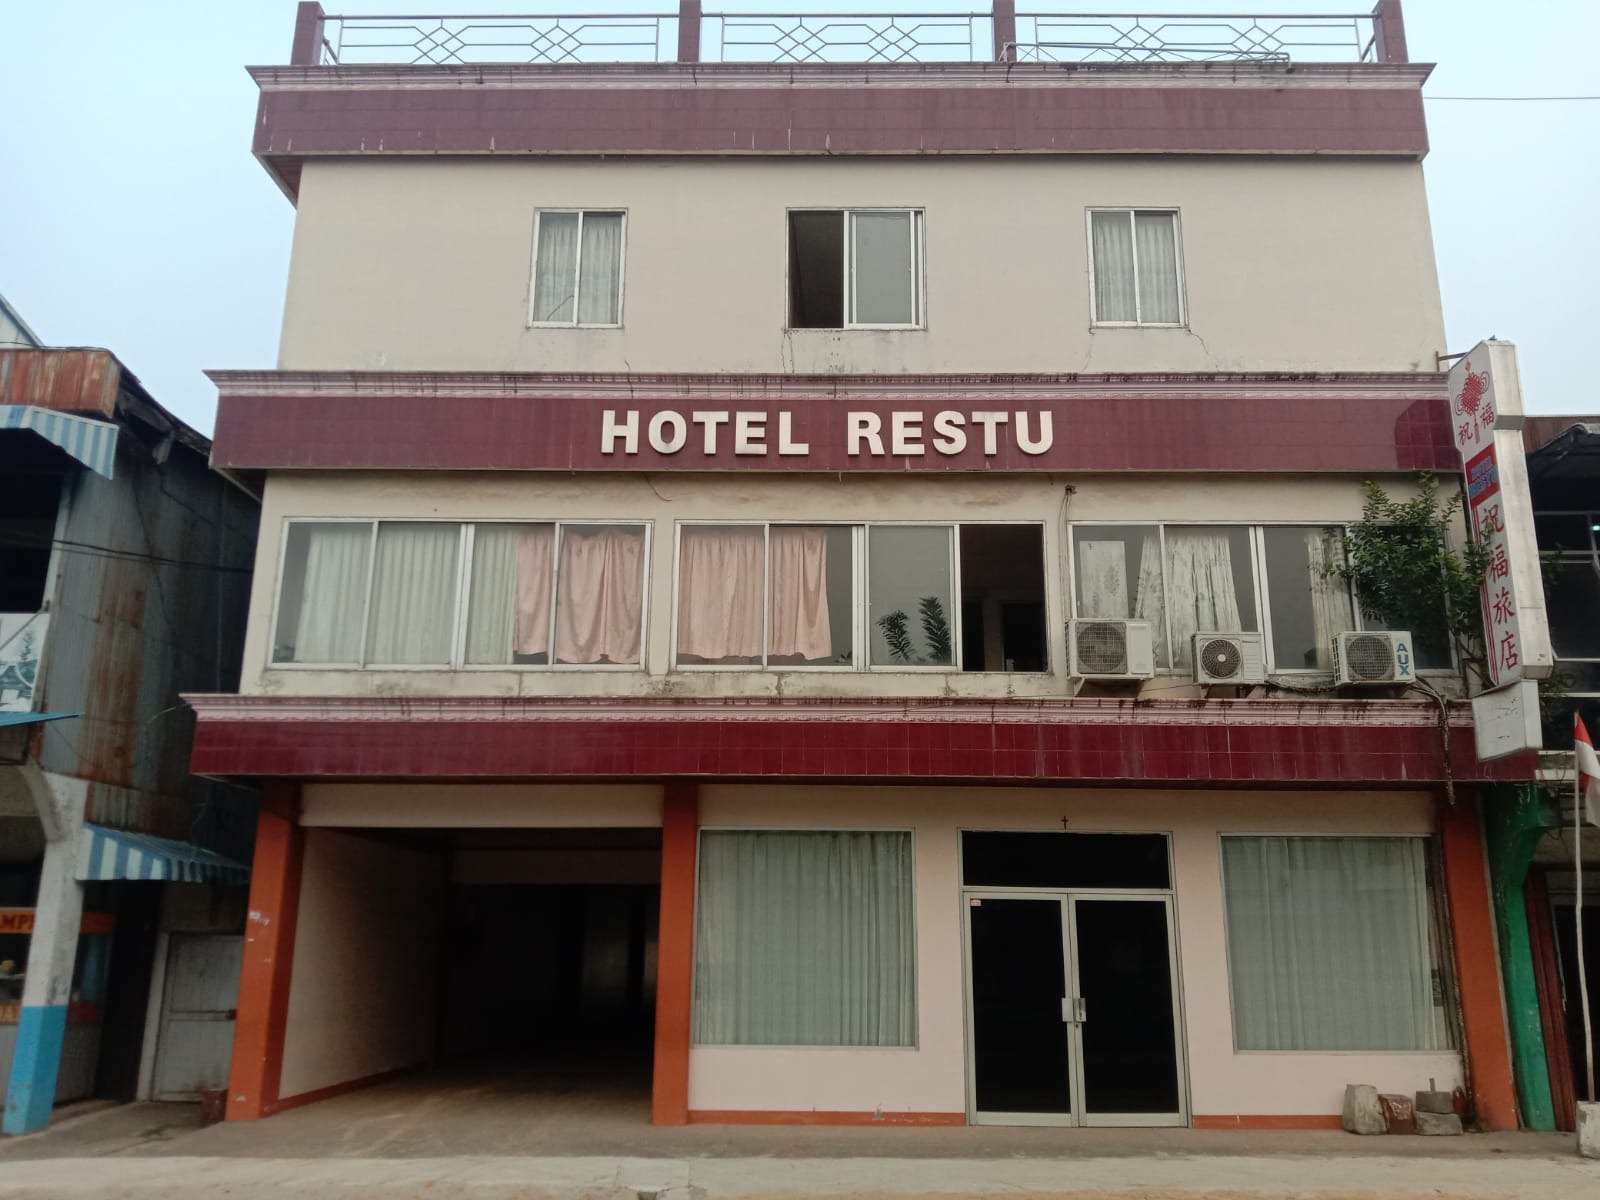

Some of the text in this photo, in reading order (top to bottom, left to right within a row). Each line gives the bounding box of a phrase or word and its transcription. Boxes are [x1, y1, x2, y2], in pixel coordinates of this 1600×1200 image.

[600, 409, 1054, 456] HOTEL RESTU
[1481, 503, 1518, 671] 祝福旅店
[1397, 643, 1410, 675] AUX
